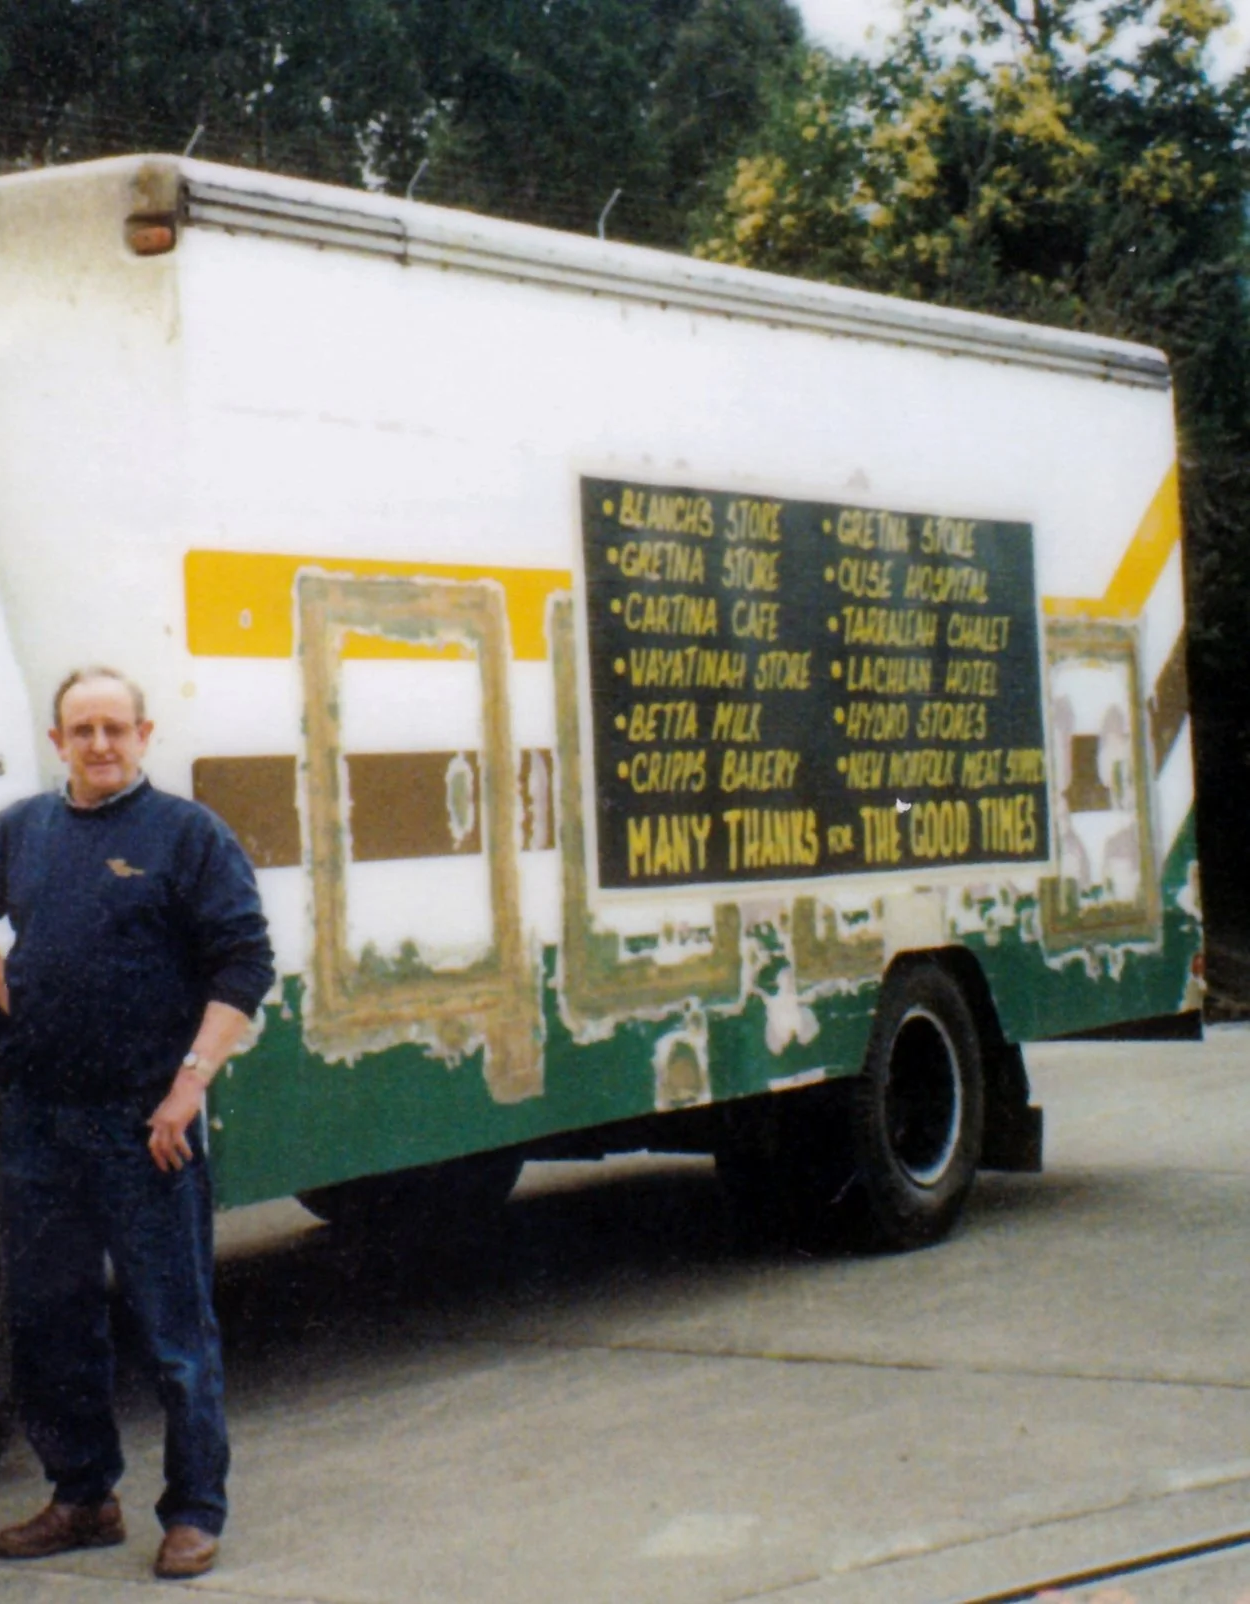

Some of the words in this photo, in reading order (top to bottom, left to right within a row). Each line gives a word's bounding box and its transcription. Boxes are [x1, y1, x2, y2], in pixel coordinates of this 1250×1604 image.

[724, 500, 782, 542] STORE
[620, 540, 705, 584] GRETNA
[721, 546, 781, 591] STORE
[837, 557, 893, 598] OUSE
[624, 591, 718, 637] CARTINA
[731, 600, 780, 642] CAFE
[946, 611, 1010, 653] CHALET
[629, 645, 747, 688] WAYATINAH
[754, 649, 811, 691] STORE
[945, 659, 998, 697] HOTEL
[628, 700, 698, 742] BETTA
[711, 701, 762, 742] MILK
[846, 700, 909, 741] HYDRO
[916, 700, 987, 741] STORES
[630, 749, 707, 794] CRIPPS
[720, 748, 800, 793] BAKERY
[846, 750, 886, 790] NEW
[961, 748, 1003, 790] MEAT
[627, 812, 712, 877] MANY
[722, 808, 819, 872] THANKS
[859, 806, 902, 863] THE
[909, 800, 970, 858] GOOD
[978, 793, 1036, 854] TIMES
